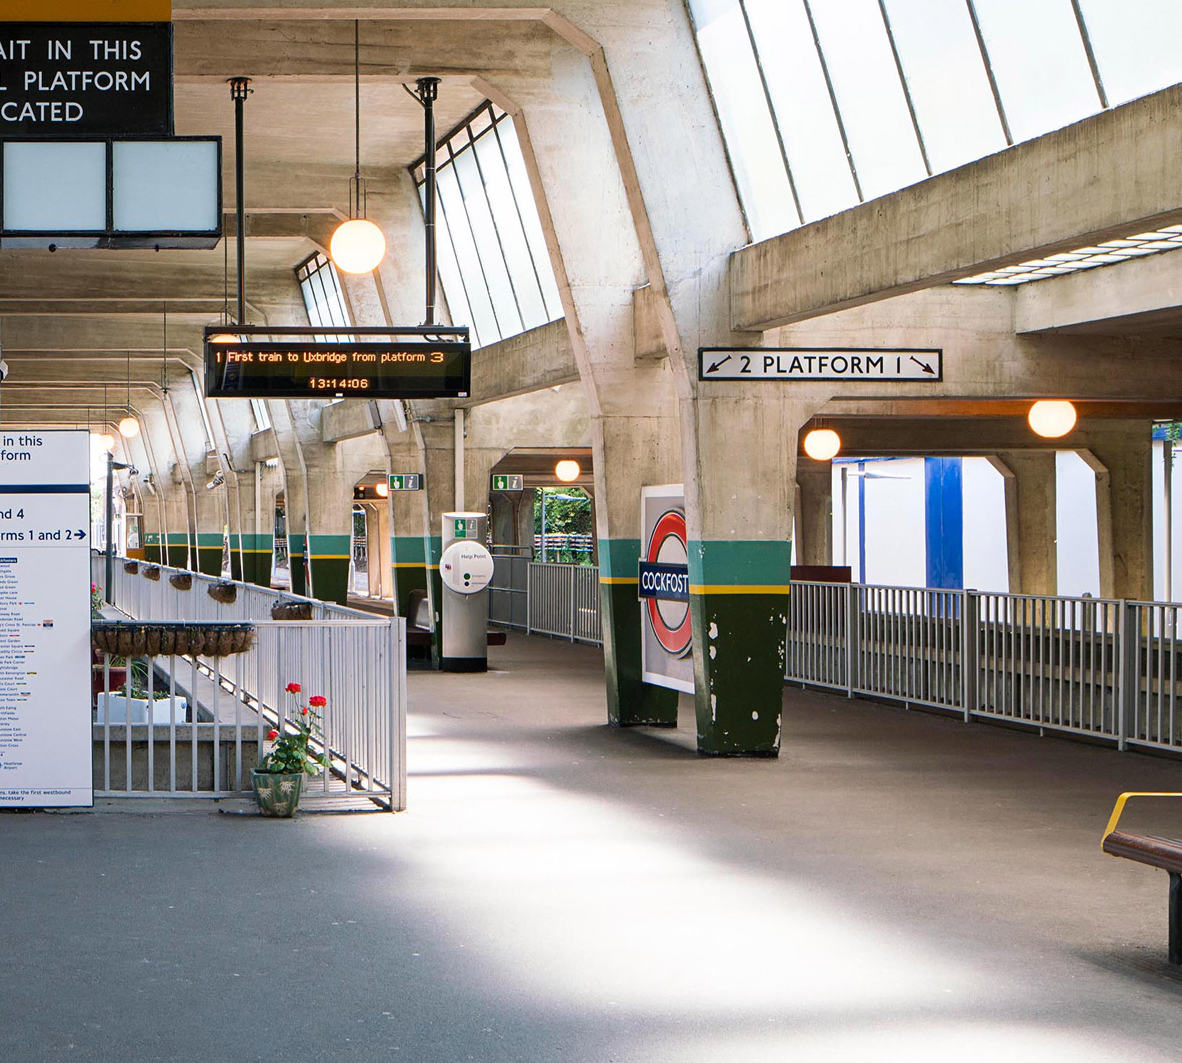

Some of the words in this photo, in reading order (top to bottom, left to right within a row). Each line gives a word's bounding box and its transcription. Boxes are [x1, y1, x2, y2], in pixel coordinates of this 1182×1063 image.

[48, 40, 72, 60] IN
[90, 40, 142, 60] THIS
[24, 71, 150, 91] PLATFORM
[216, 352, 221, 362] 1
[227, 352, 253, 362] First
[259, 352, 282, 362] train
[288, 353, 299, 362] to
[303, 353, 347, 363] Uxbridge
[352, 353, 376, 362] from
[381, 353, 425, 363] platform
[430, 353, 444, 362] 3
[740, 356, 751, 373] 2
[764, 356, 883, 373] PLATFORM
[309, 379, 368, 389] 13:14:06
[3, 436, 14, 446] in
[19, 436, 43, 446] this
[17, 509, 24, 519] 4
[29, 530, 33, 540] 1
[38, 530, 60, 540] and
[65, 530, 72, 540] 2
[642, 572, 688, 593] COCKFOST
